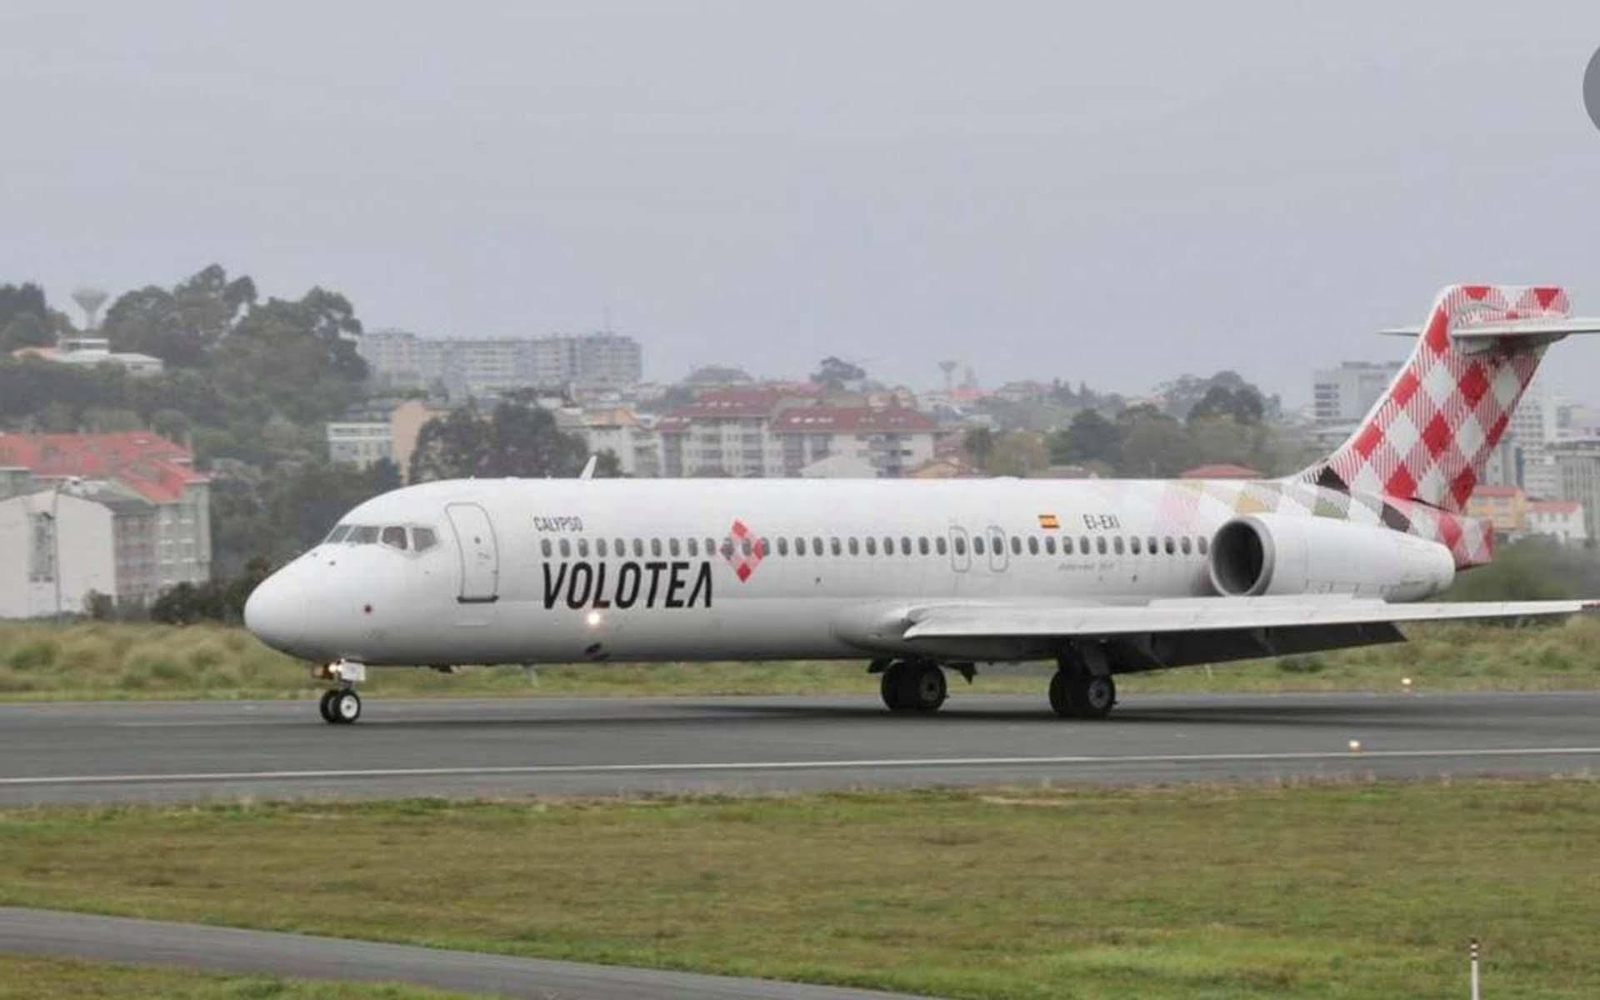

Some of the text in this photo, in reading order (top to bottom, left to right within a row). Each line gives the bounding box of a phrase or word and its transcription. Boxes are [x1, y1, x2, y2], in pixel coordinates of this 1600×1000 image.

[533, 516, 584, 532] CALYPSO
[1082, 514, 1121, 529] EI-EXI
[542, 561, 713, 609] VOLOTEA
